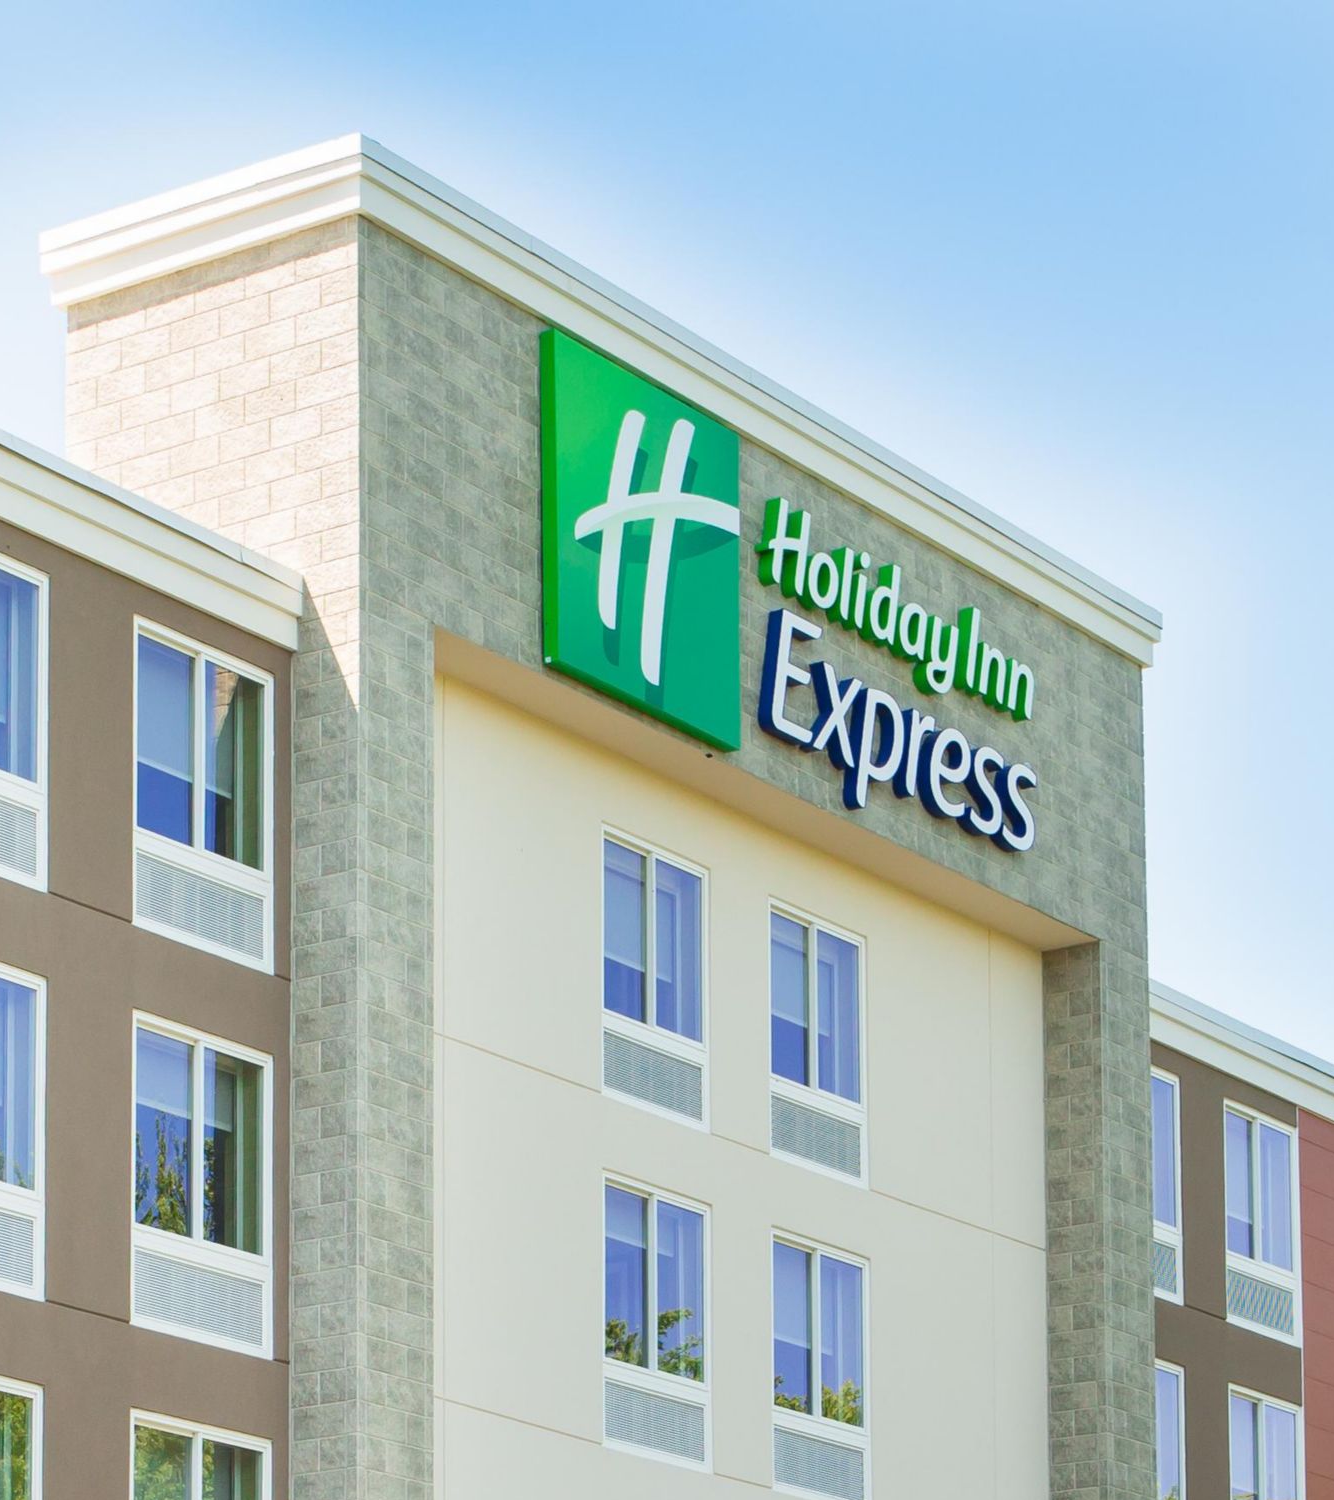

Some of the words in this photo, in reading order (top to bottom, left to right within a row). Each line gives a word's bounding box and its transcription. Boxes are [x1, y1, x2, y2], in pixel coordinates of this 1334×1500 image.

[758, 497, 960, 695] Holiday
[960, 606, 1035, 722] Inn
[760, 608, 1037, 852] Express
